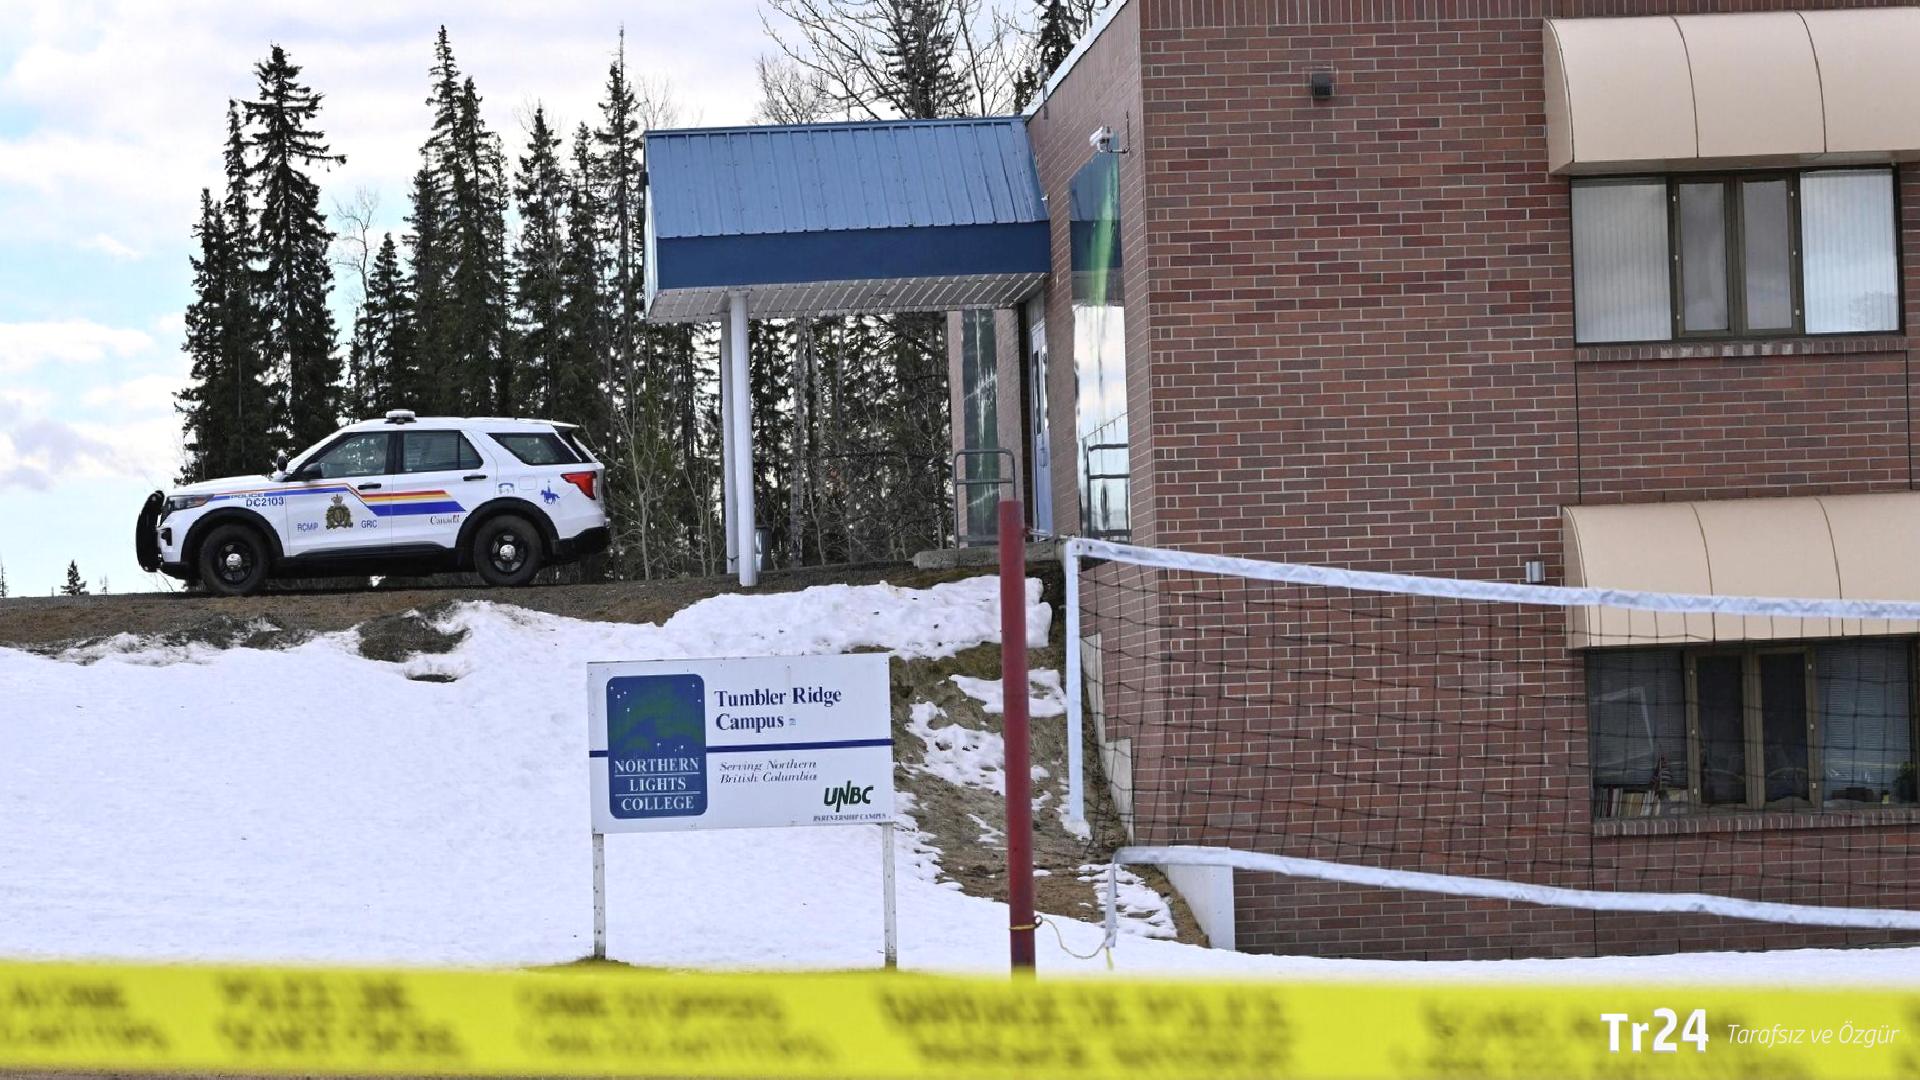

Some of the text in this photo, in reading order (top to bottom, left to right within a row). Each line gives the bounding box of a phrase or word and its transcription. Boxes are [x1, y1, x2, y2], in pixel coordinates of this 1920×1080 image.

[245, 496, 285, 507] DC2103
[297, 522, 319, 532] RCMP
[361, 520, 378, 529] GRC
[714, 686, 842, 707] Tumbler Ridge
[715, 713, 785, 733] Campus
[614, 757, 700, 773] NORTHERN
[719, 759, 817, 772] Serving Northern
[629, 777, 686, 793] LIGHTS
[720, 771, 818, 784] British Columbia
[620, 795, 695, 812] COLLEGE
[823, 780, 875, 813] UNBC
